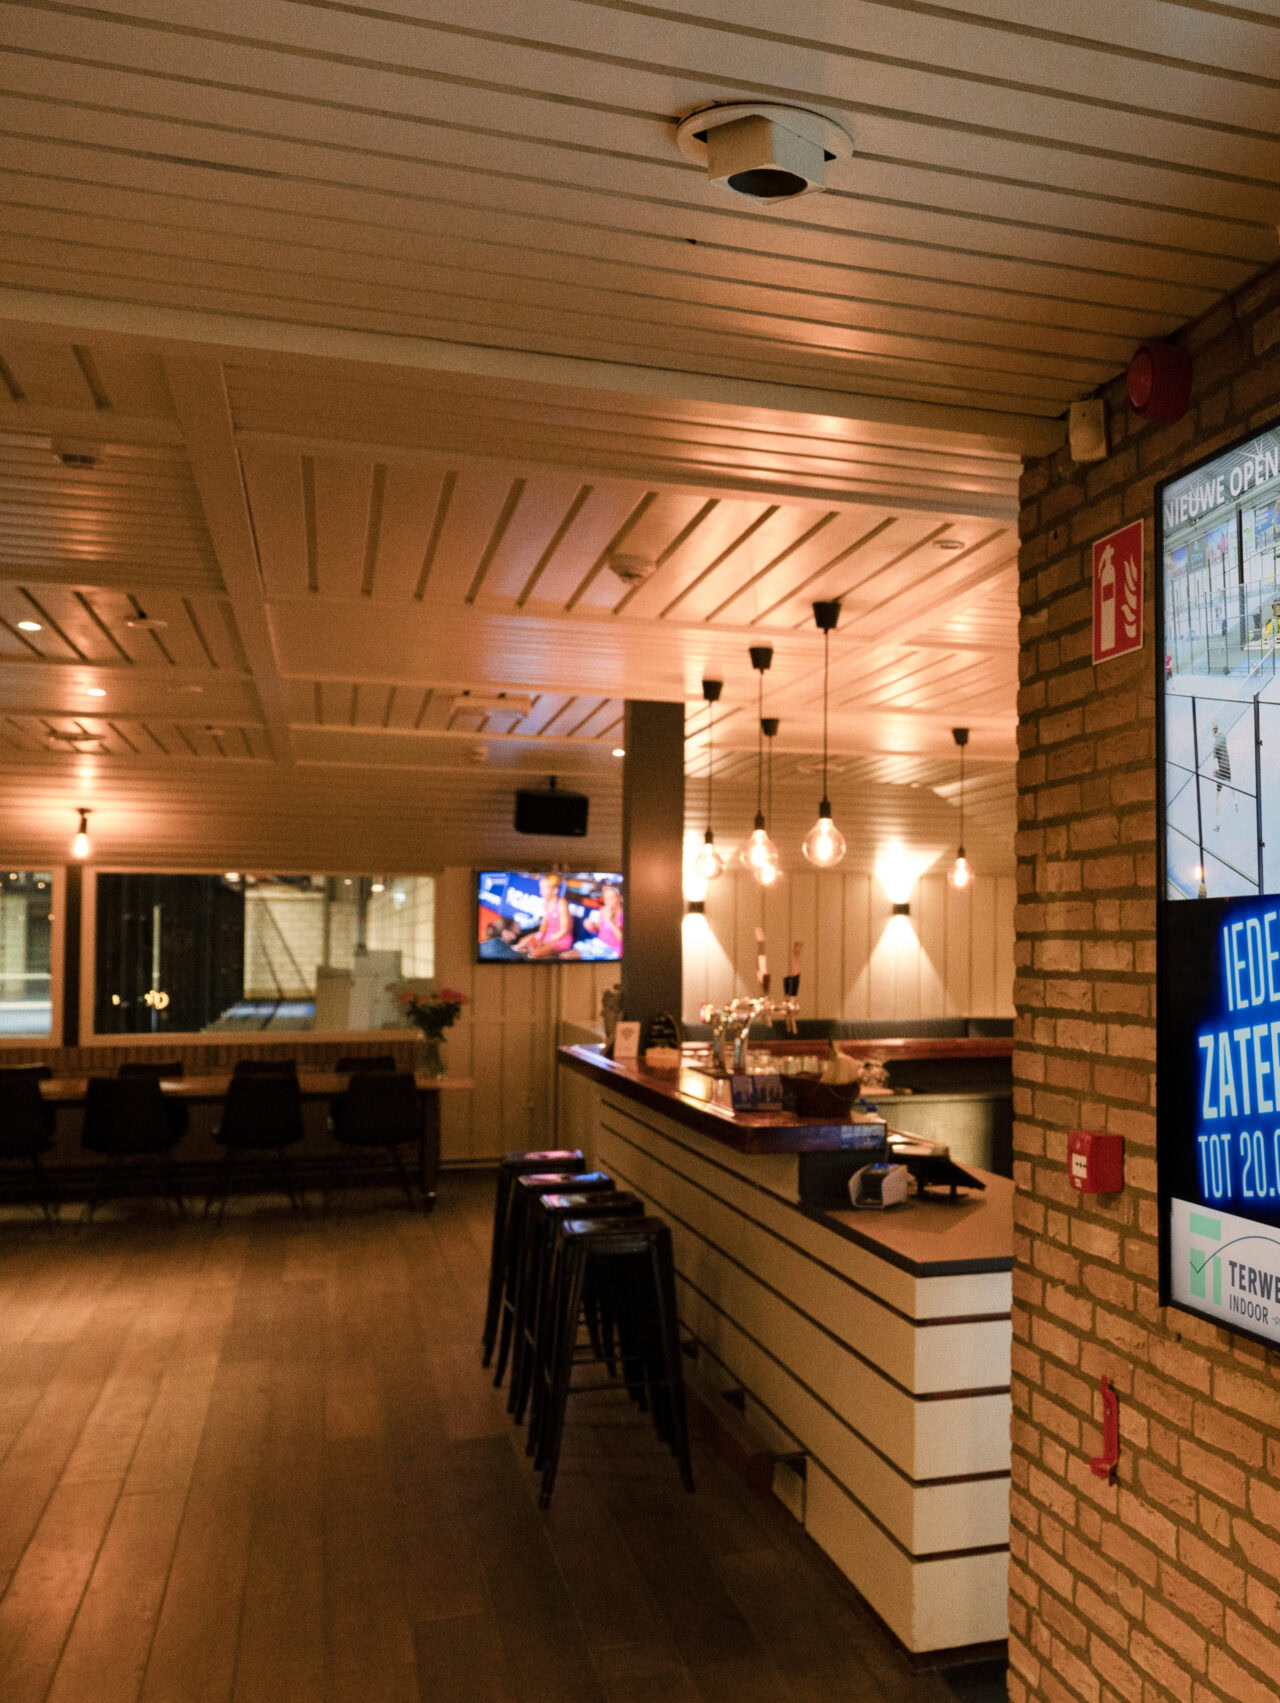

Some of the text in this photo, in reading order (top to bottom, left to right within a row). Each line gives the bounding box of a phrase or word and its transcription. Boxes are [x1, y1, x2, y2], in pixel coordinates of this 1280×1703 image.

[1164, 475, 1225, 528] NIEUWE
[1198, 1133, 1232, 1198] TOT
[1229, 1293, 1269, 1325] INDOOR
